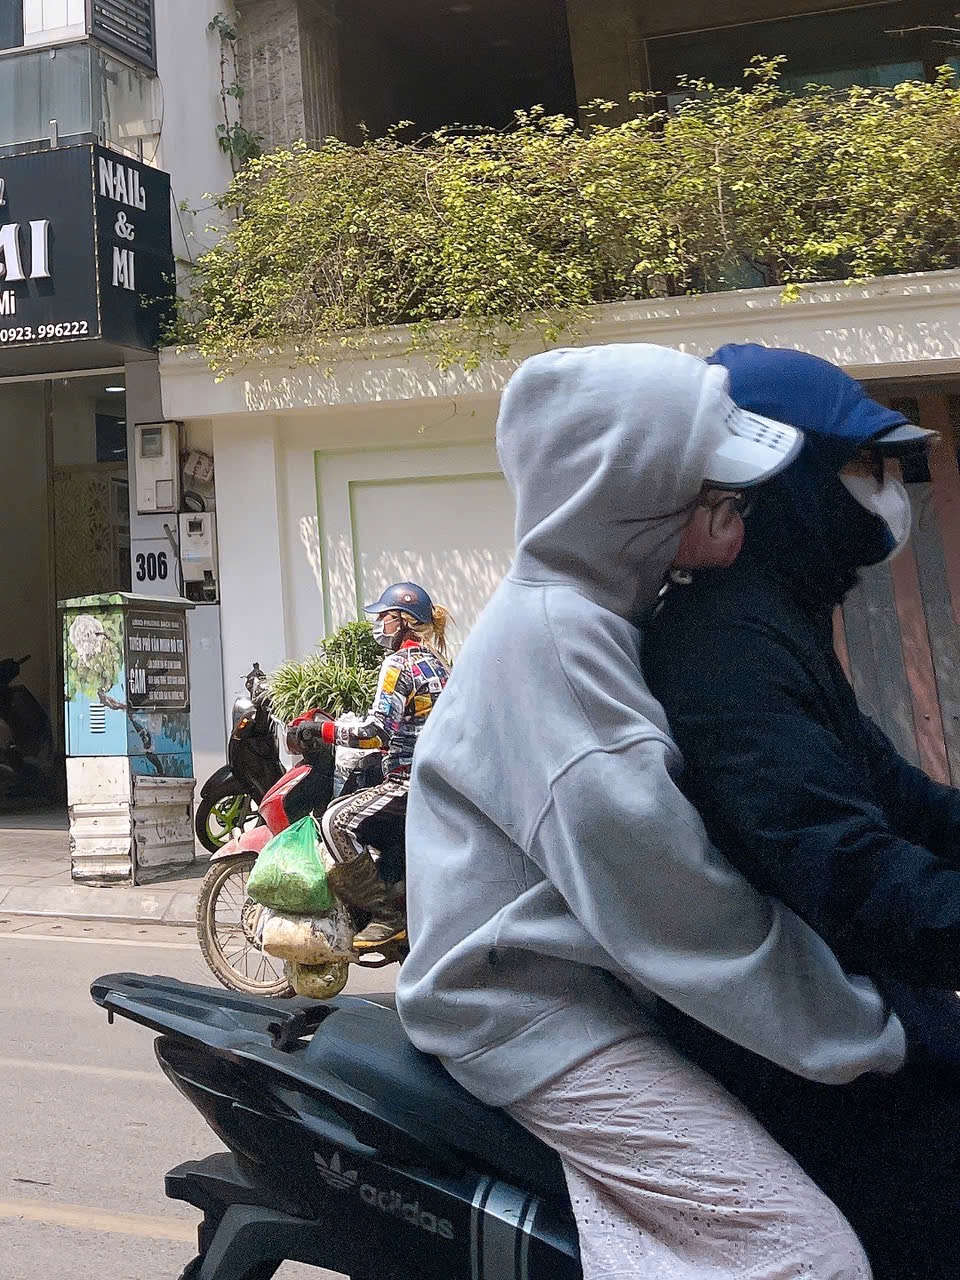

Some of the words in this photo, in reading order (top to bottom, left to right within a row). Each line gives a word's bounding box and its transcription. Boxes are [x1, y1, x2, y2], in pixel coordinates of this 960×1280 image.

[99, 156, 146, 211] NAIL
[115, 211, 135, 240] &
[112, 246, 135, 291] MI
[0, 320, 89, 342] 0923.996222
[135, 552, 168, 581] 306
[359, 1182, 455, 1240] adidas
